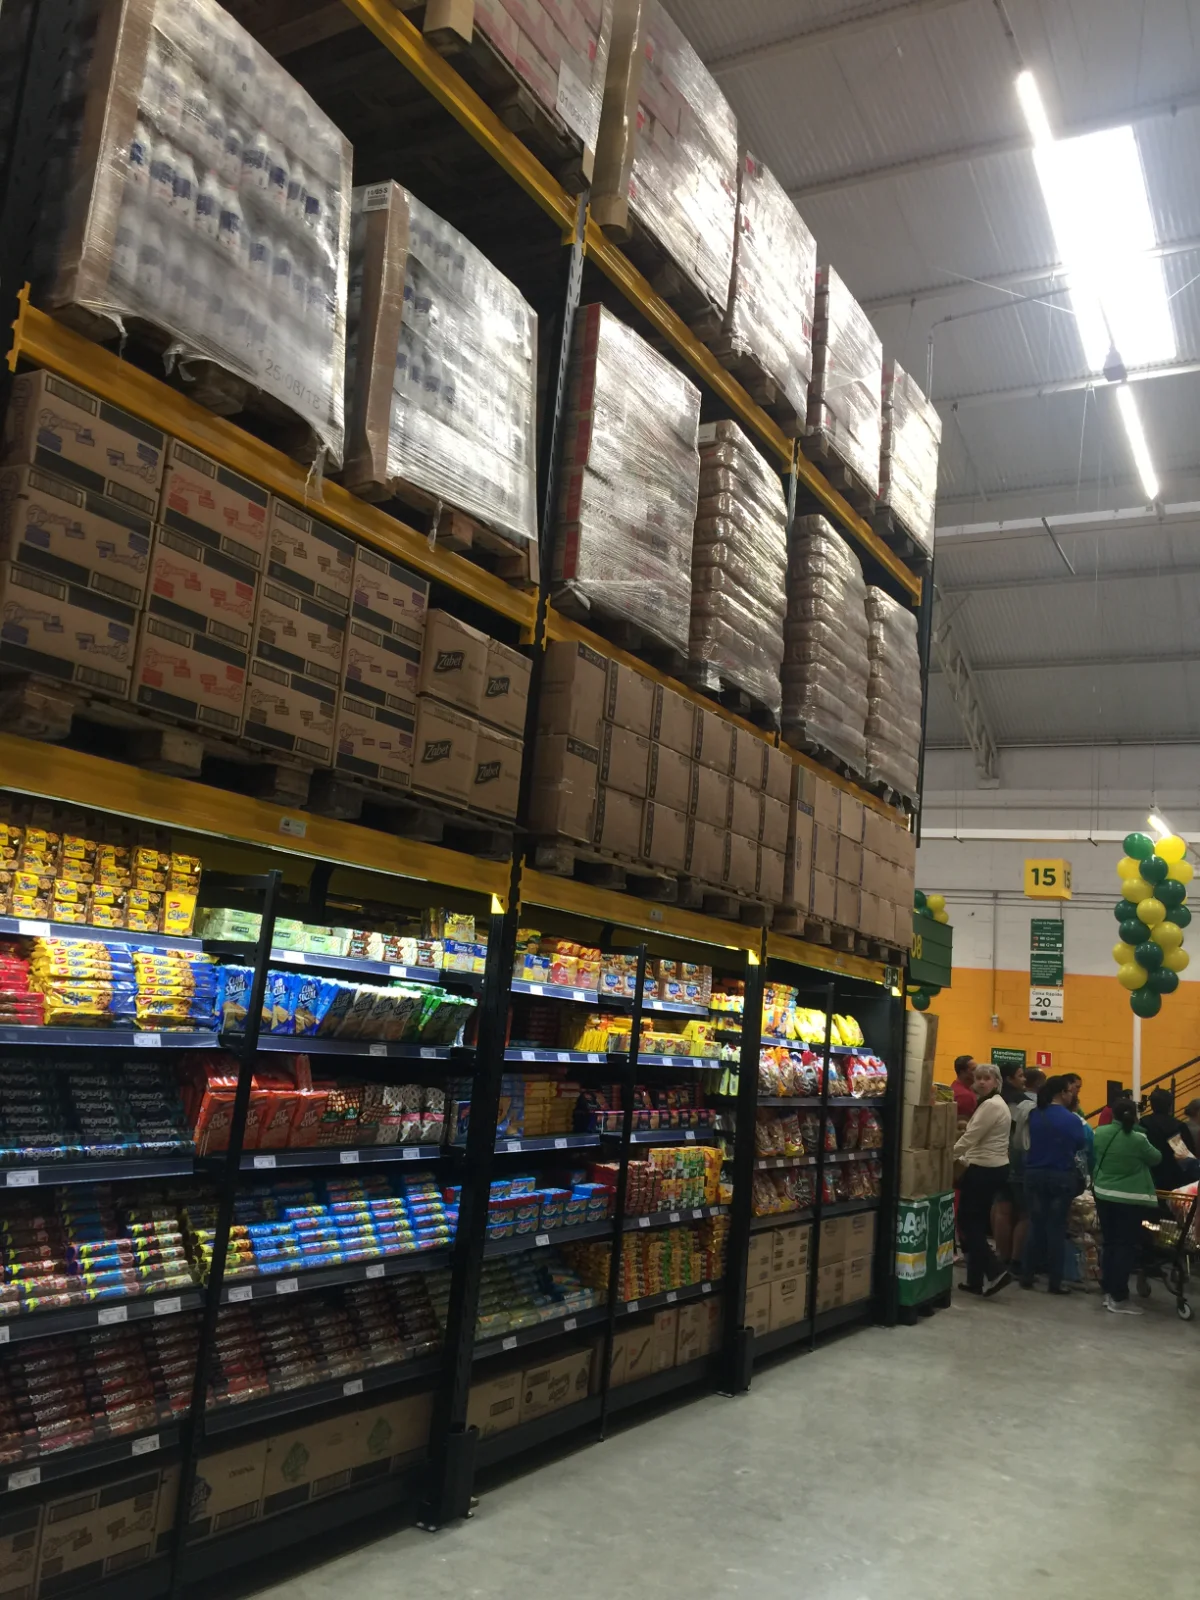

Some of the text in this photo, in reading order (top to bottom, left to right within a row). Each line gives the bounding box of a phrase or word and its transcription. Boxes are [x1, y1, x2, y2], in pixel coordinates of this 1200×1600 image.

[436, 651, 464, 670] Zabet
[487, 677, 510, 695] Zabet
[424, 743, 451, 762] Zabet
[476, 763, 500, 782] Zabet
[1031, 868, 1056, 886] 15
[1063, 870, 1071, 889] 15
[1035, 997, 1051, 1008] 20
